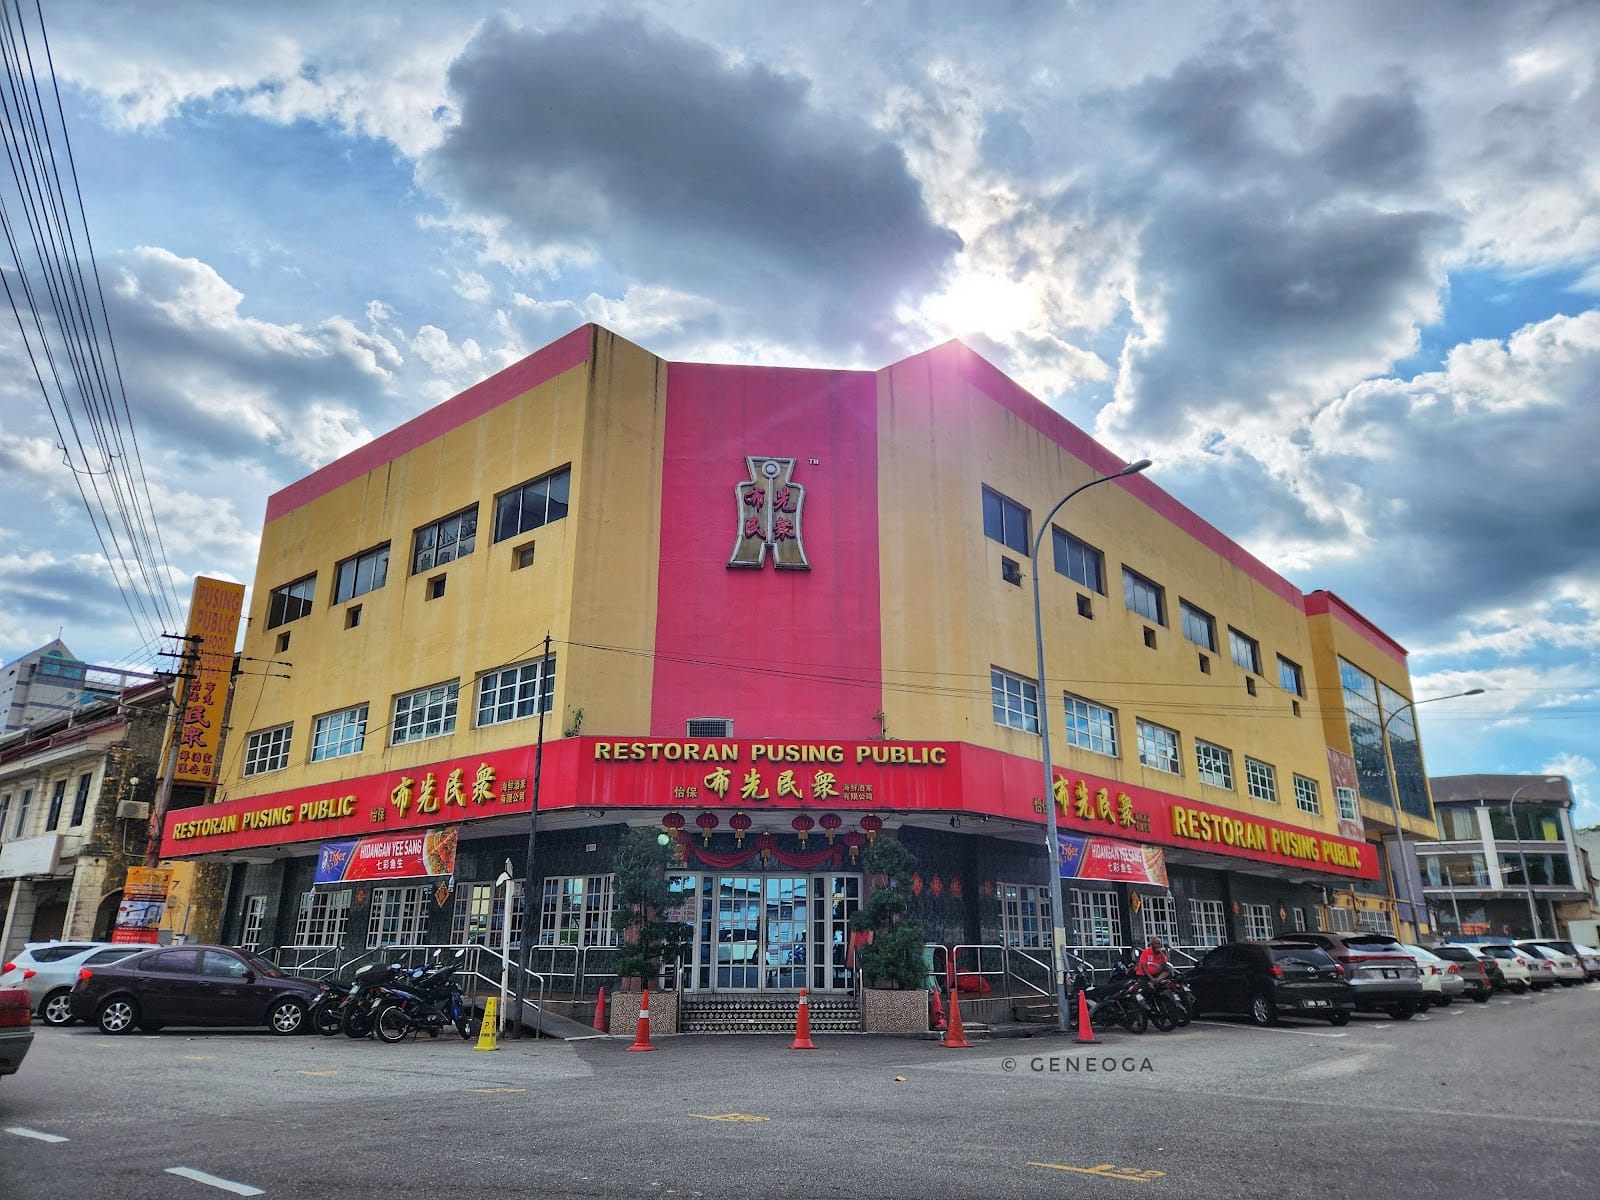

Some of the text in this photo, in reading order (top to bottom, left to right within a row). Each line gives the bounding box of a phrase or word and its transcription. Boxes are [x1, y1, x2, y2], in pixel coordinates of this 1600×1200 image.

[197, 585, 240, 613] PUSING
[196, 608, 235, 636] PUBLIC
[594, 742, 946, 765] RESTORAN PUSING PUBLIC
[674, 786, 697, 799] 怡保
[172, 795, 357, 841] RESTORAN PUSING PUBLIC
[1171, 805, 1267, 850] RESTORAN
[1270, 828, 1319, 862] PUSING
[1321, 839, 1361, 869] PUBLIC
[329, 849, 347, 867] Tiger
[360, 839, 422, 859] HIDANGAN YEE SANG
[1061, 843, 1079, 861] Tiger
[1092, 844, 1120, 860] HIDANGAN
